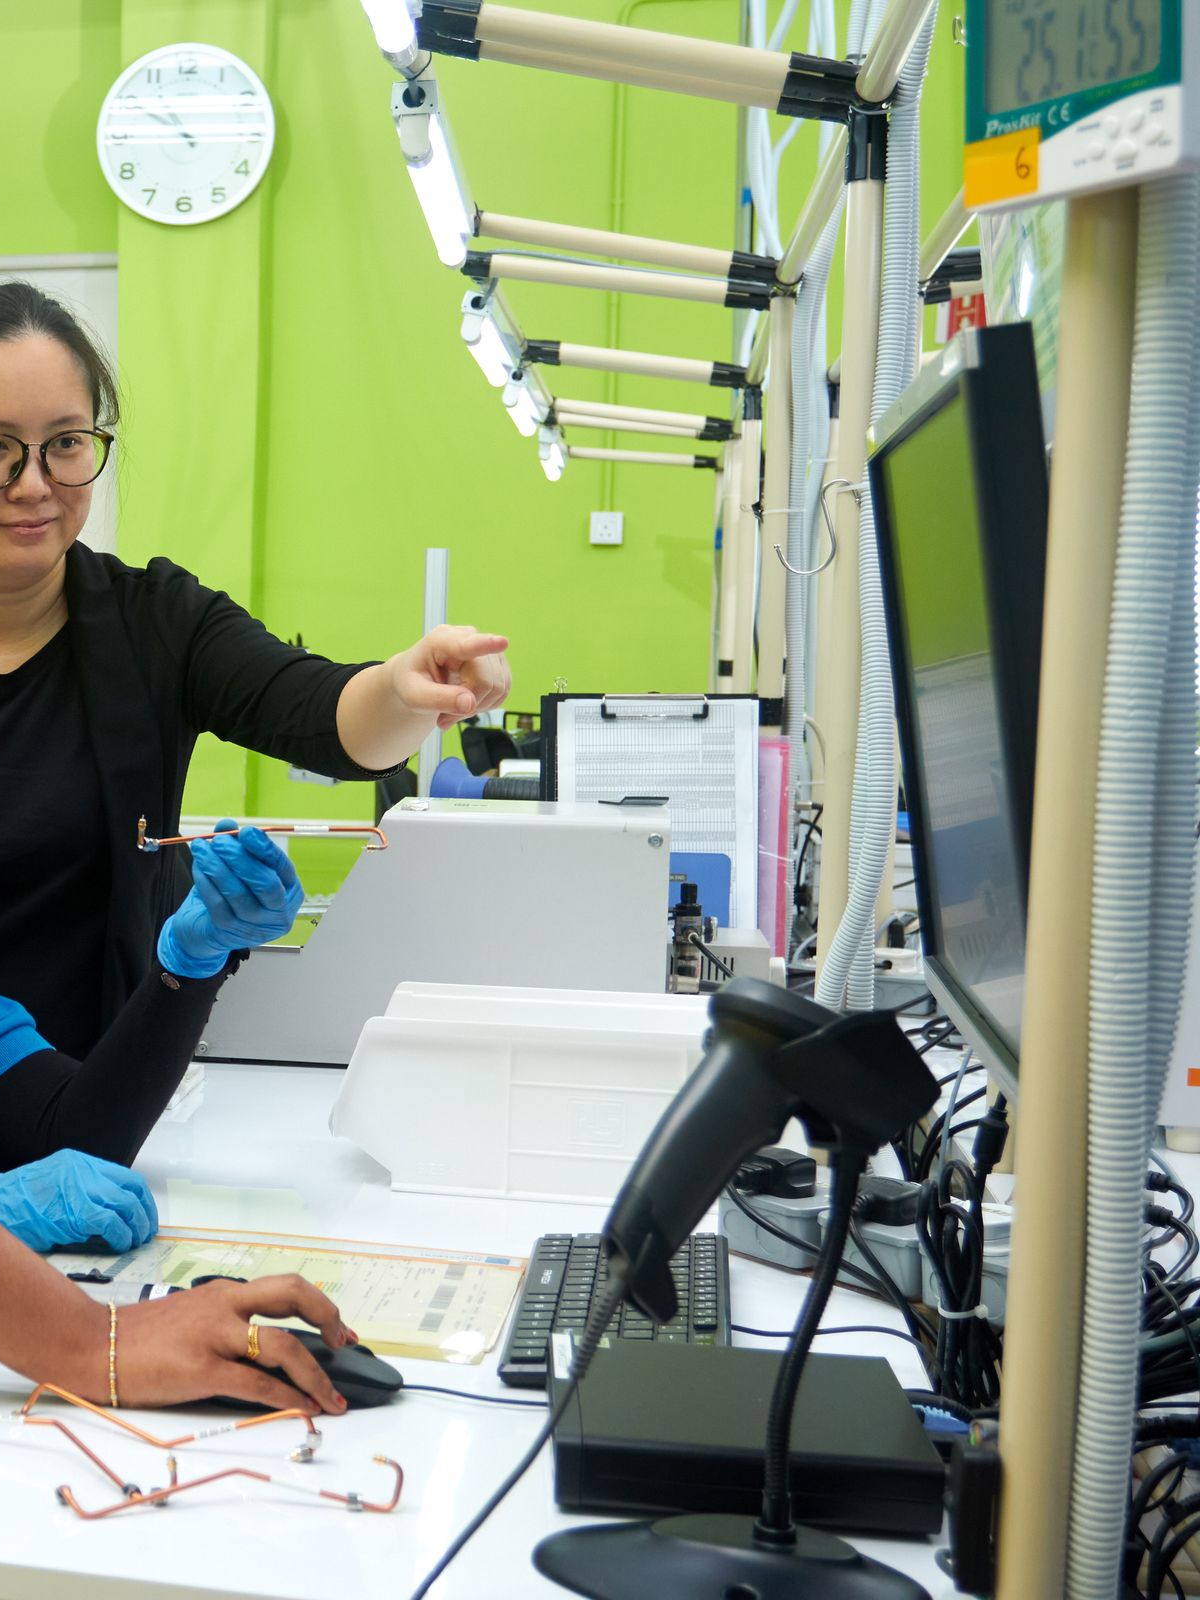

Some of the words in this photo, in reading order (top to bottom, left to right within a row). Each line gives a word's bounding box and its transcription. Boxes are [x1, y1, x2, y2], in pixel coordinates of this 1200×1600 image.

[119, 162, 135, 180] 8
[234, 158, 250, 177] 4
[1015, 145, 1031, 180] 6
[141, 188, 157, 206] 7
[211, 186, 226, 204] 5
[175, 196, 193, 213] 6
